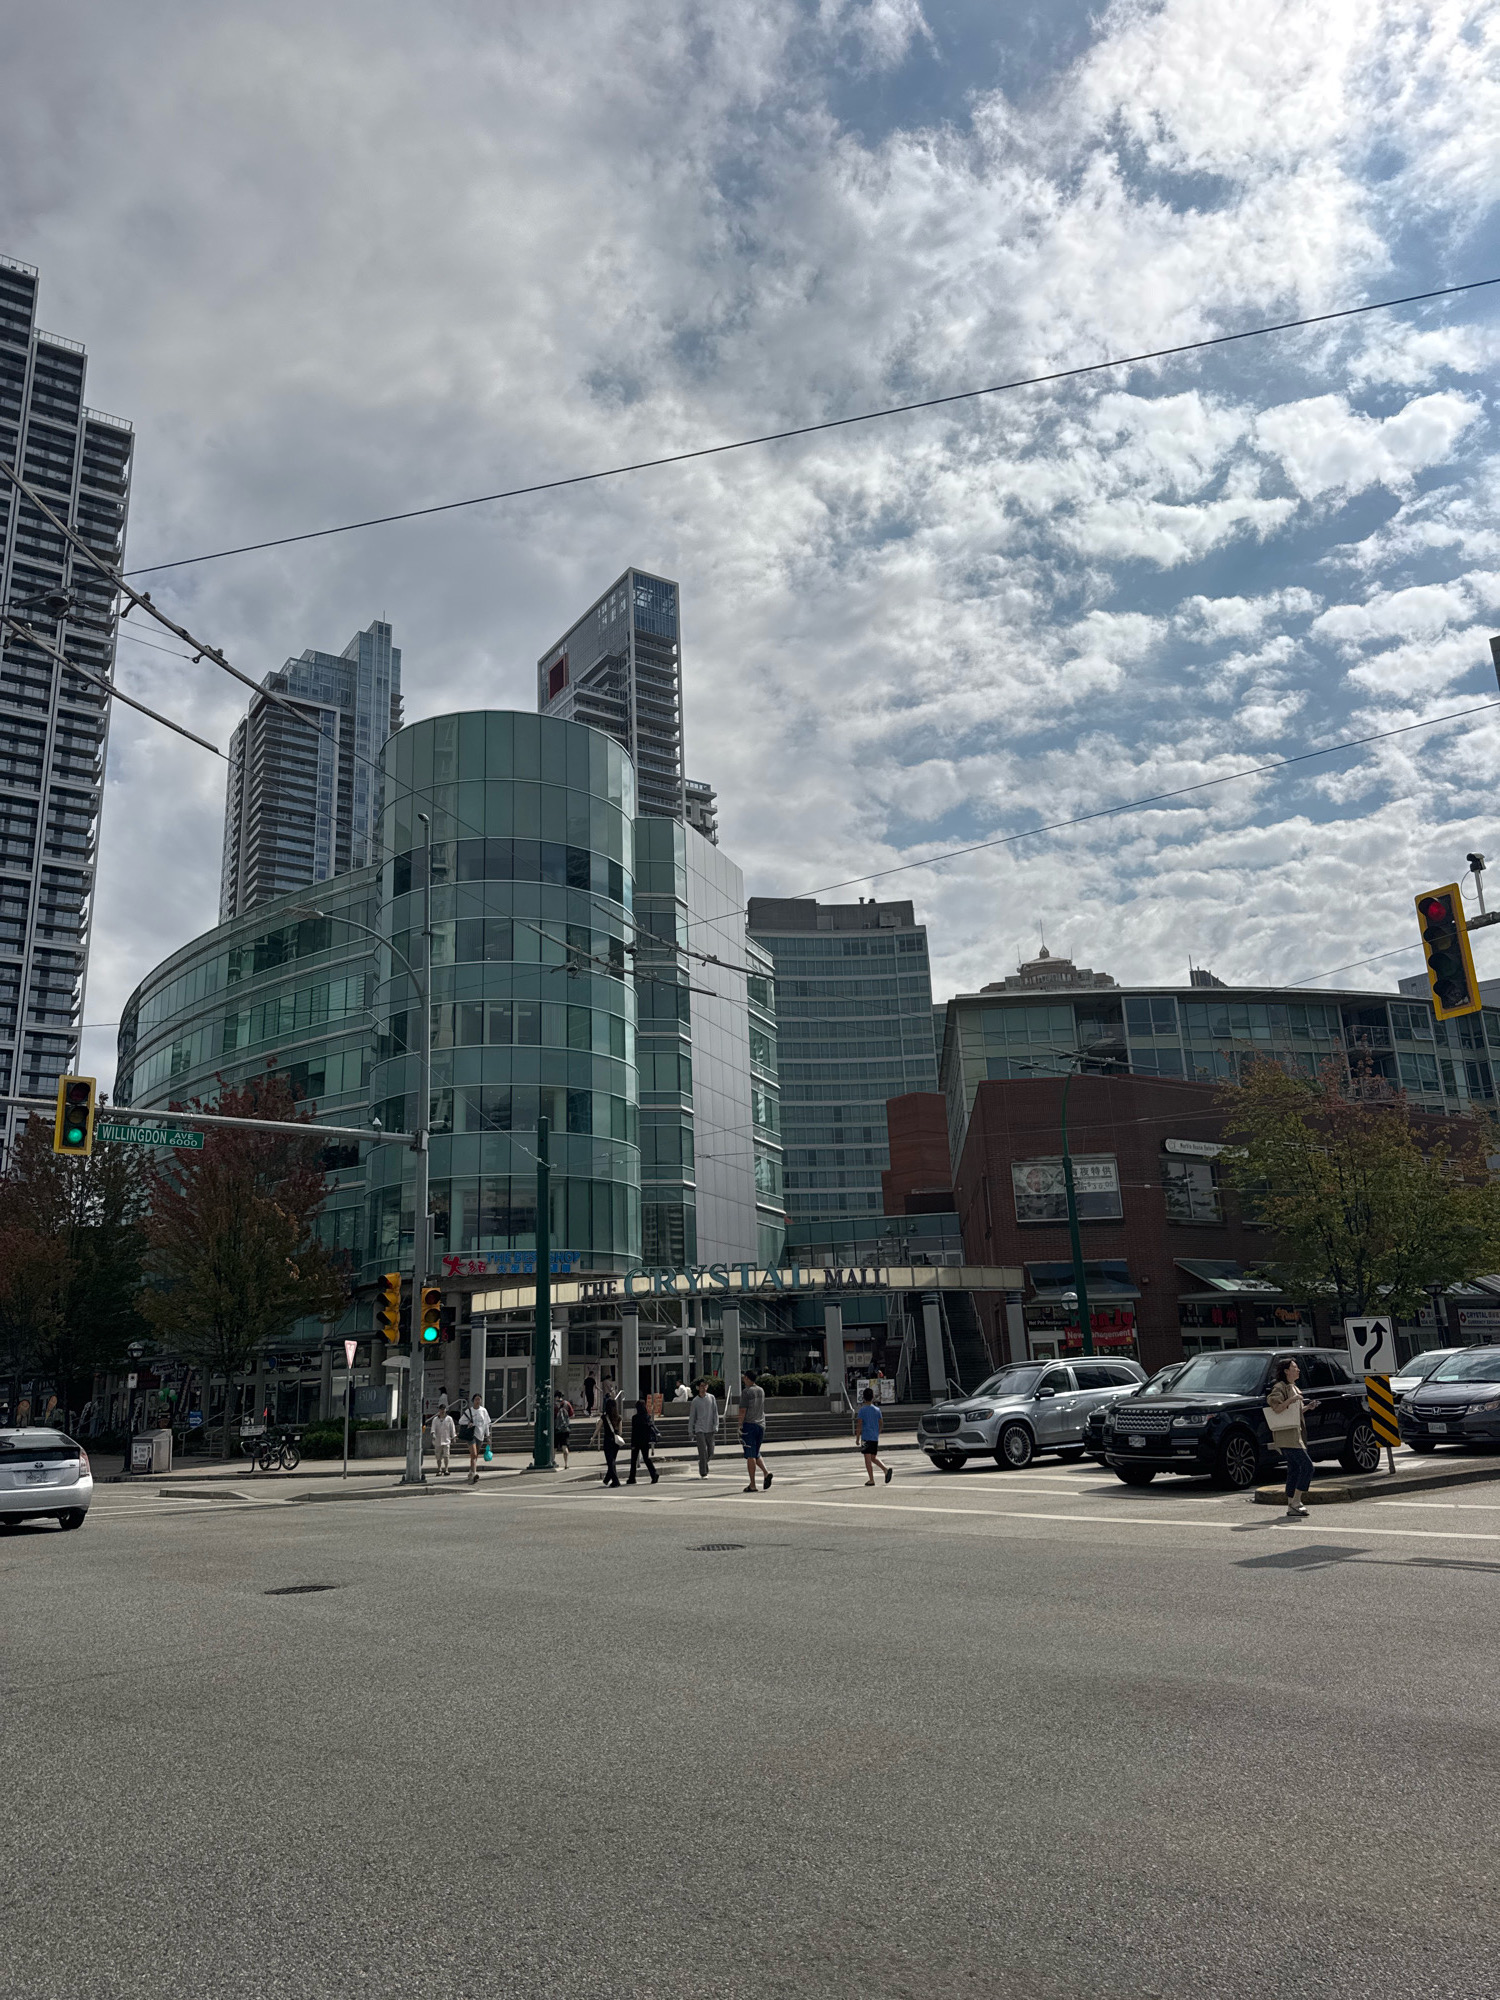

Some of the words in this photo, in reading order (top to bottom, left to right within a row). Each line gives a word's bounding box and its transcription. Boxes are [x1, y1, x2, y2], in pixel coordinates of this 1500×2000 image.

[102, 1125, 168, 1144] WILLINGDON
[174, 1132, 195, 1140] AVE
[169, 1138, 198, 1147] 6000
[486, 1251, 512, 1264] THE
[514, 1250, 537, 1263] BES
[580, 1279, 618, 1301] THE
[624, 1260, 815, 1299] CRYSTAL
[823, 1266, 887, 1290] MALL
[1092, 1328, 1132, 1340] anagement
